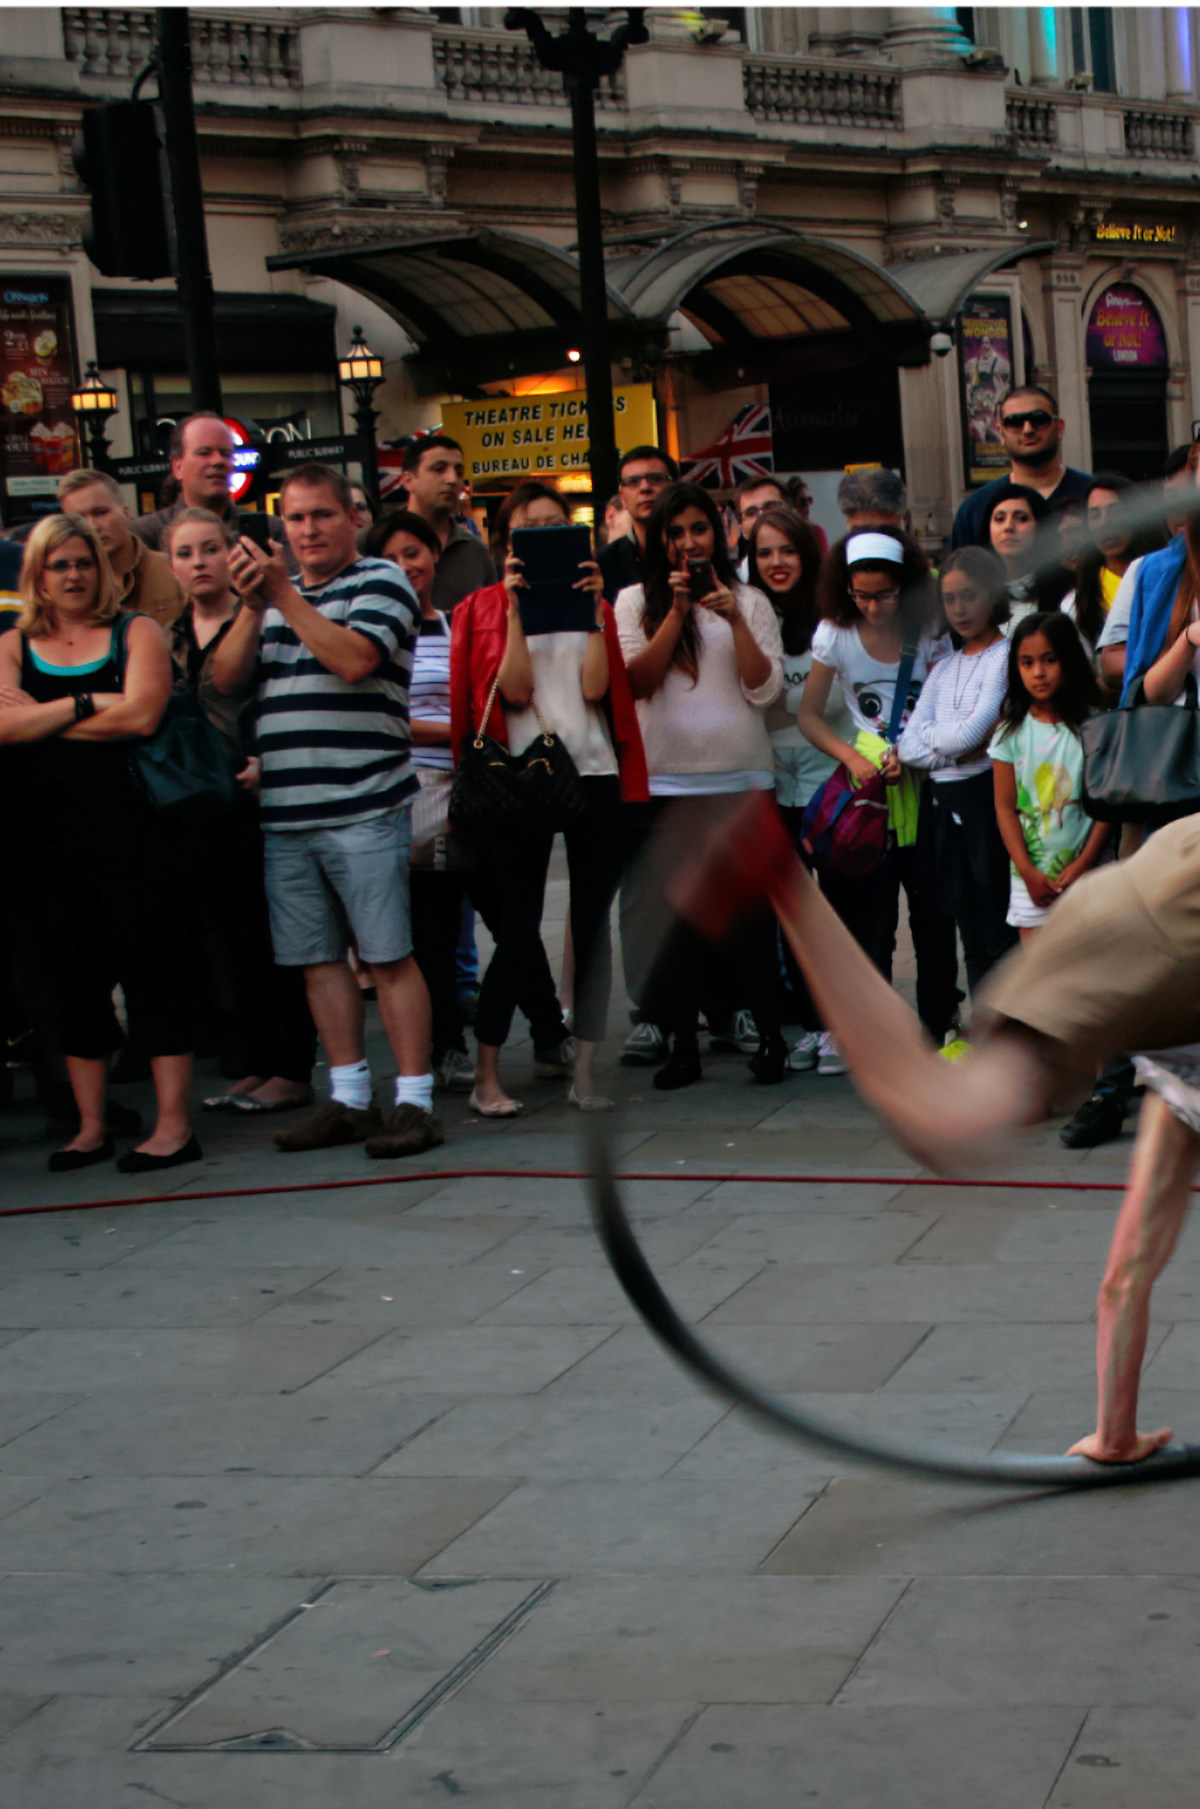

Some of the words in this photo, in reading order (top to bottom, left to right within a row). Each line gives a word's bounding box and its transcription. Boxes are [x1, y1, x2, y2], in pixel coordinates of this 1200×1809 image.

[1096, 223, 1132, 240] Believe
[1132, 224, 1143, 241] It
[1143, 228, 1155, 242] or
[1097, 308, 1137, 326] Believe
[1138, 307, 1150, 327] It
[1104, 334, 1116, 347] or
[465, 403, 543, 427] THEATRE
[550, 397, 627, 420] TICKS
[482, 432, 507, 448] ON
[513, 426, 556, 446] SALE
[563, 423, 590, 442] HE
[472, 458, 532, 476] BUREAU
[537, 455, 555, 470] DE
